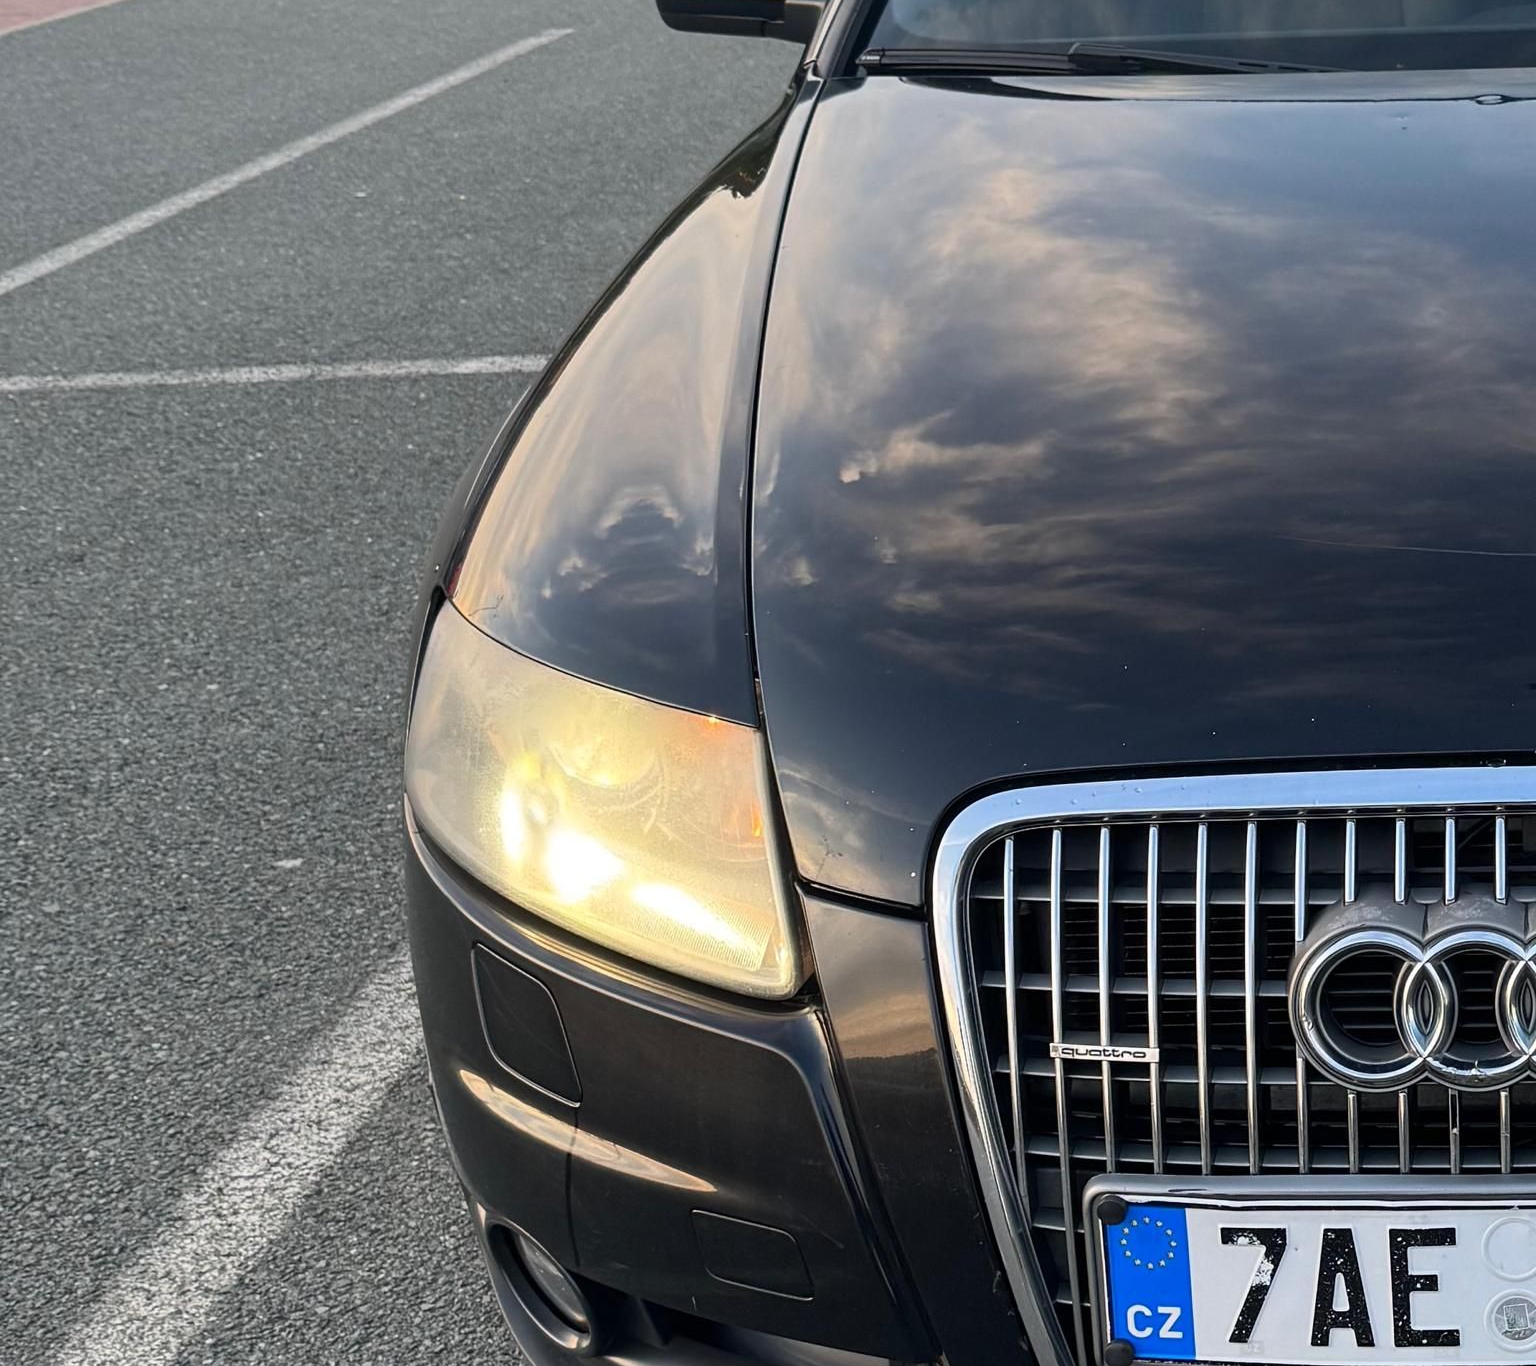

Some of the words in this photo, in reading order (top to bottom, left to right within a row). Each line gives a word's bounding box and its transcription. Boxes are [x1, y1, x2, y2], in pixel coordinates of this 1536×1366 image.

[1061, 1047, 1147, 1058] quattro
[1220, 1226, 1461, 1347] 7AE
[1126, 1304, 1184, 1339] CZ
